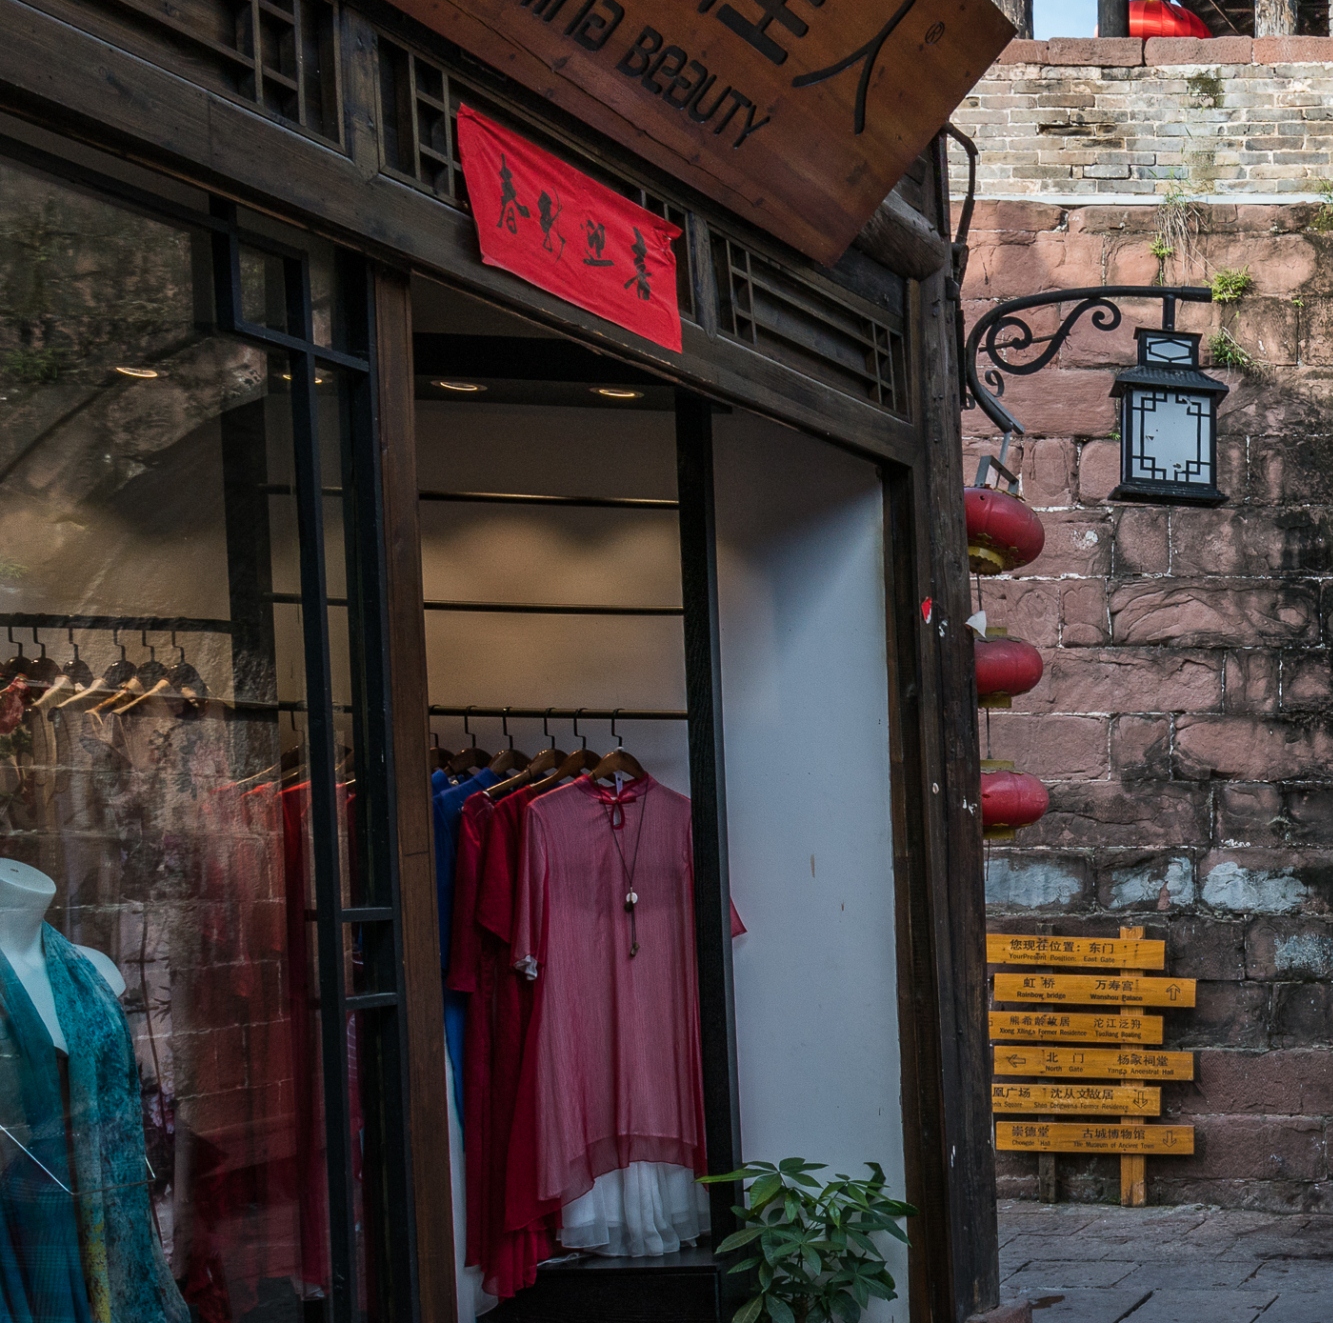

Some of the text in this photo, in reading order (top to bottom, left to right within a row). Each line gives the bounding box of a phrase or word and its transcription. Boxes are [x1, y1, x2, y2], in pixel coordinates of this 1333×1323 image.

[1089, 942, 1115, 954] 东门
[1023, 977, 1134, 992] 虹桥 万寿宫
[1016, 991, 1143, 1002] Rainbow bridge Wanshou Palace
[1009, 1015, 1142, 1029] 熊希龄故居 沱江泛舟
[1046, 1052, 1169, 1067] 北门 杨家祠堂
[1045, 1065, 1063, 1073] North
[1050, 1088, 1114, 1100] 沈从文故居
[1012, 1125, 1146, 1140] 崇德堂 古城博物馆
